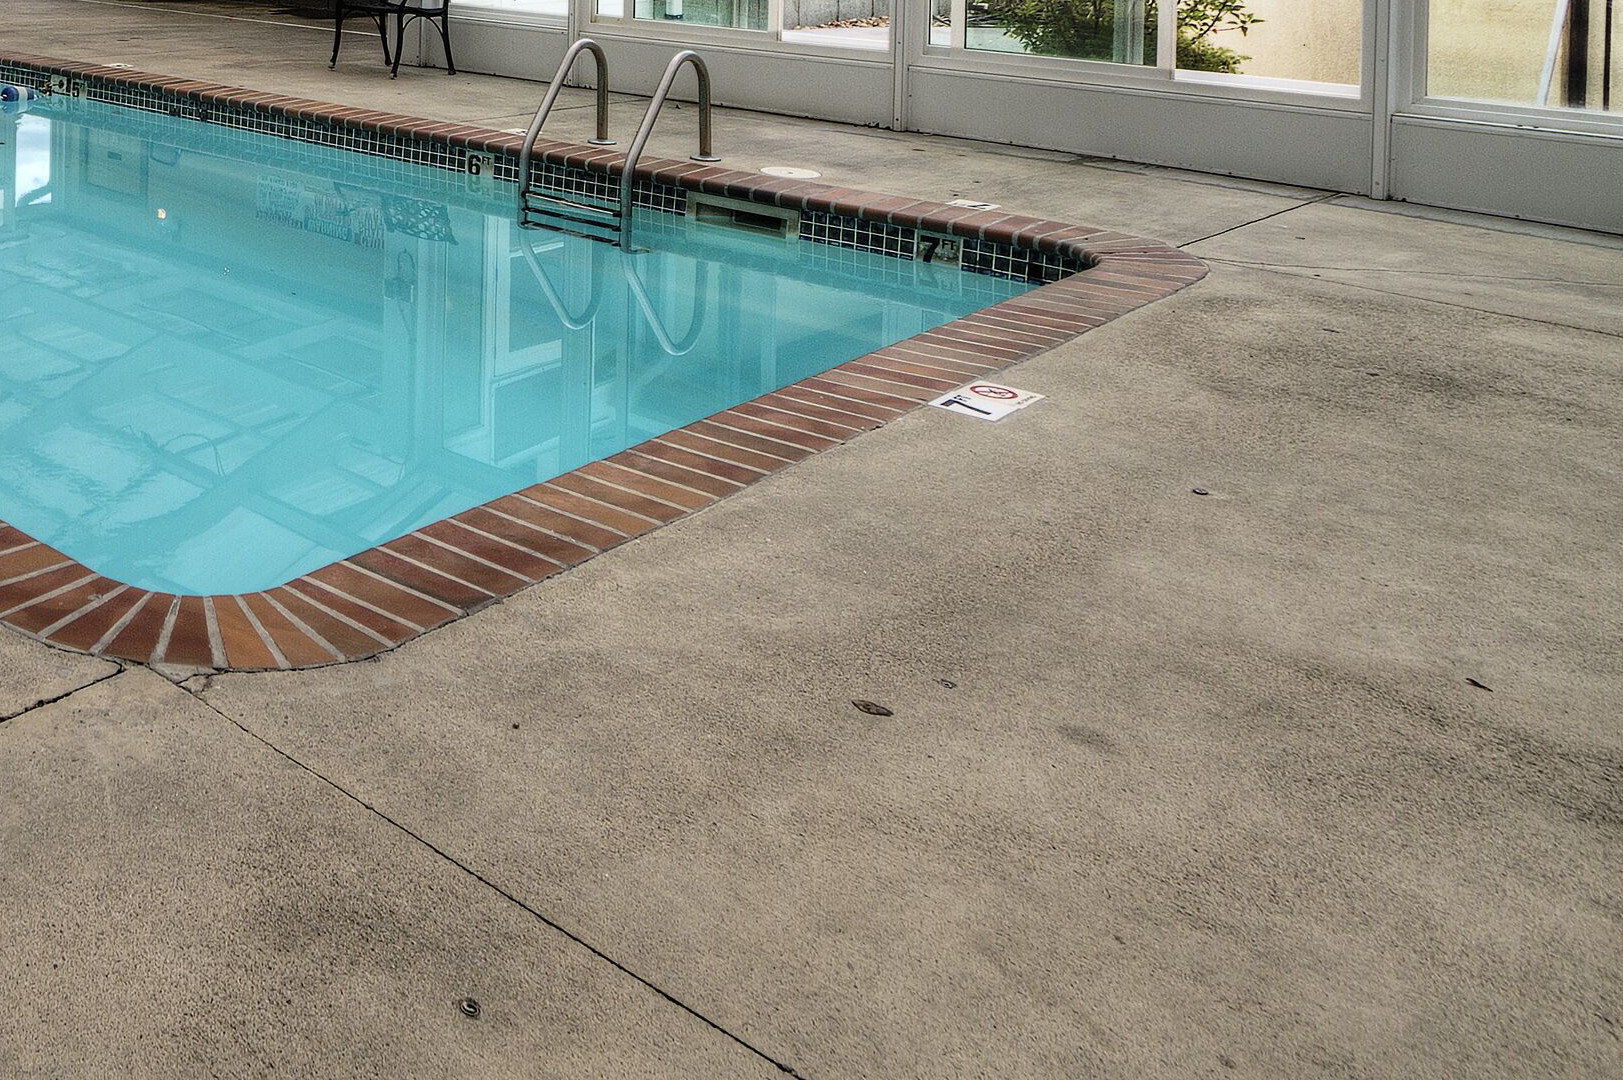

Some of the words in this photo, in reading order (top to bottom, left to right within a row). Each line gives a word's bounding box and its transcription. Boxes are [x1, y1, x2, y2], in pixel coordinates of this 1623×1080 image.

[72, 81, 79, 97] 5
[468, 154, 481, 176] 6
[482, 156, 492, 165] FT
[920, 235, 940, 263] 7
[942, 239, 956, 250] FT
[940, 399, 992, 415] 7
